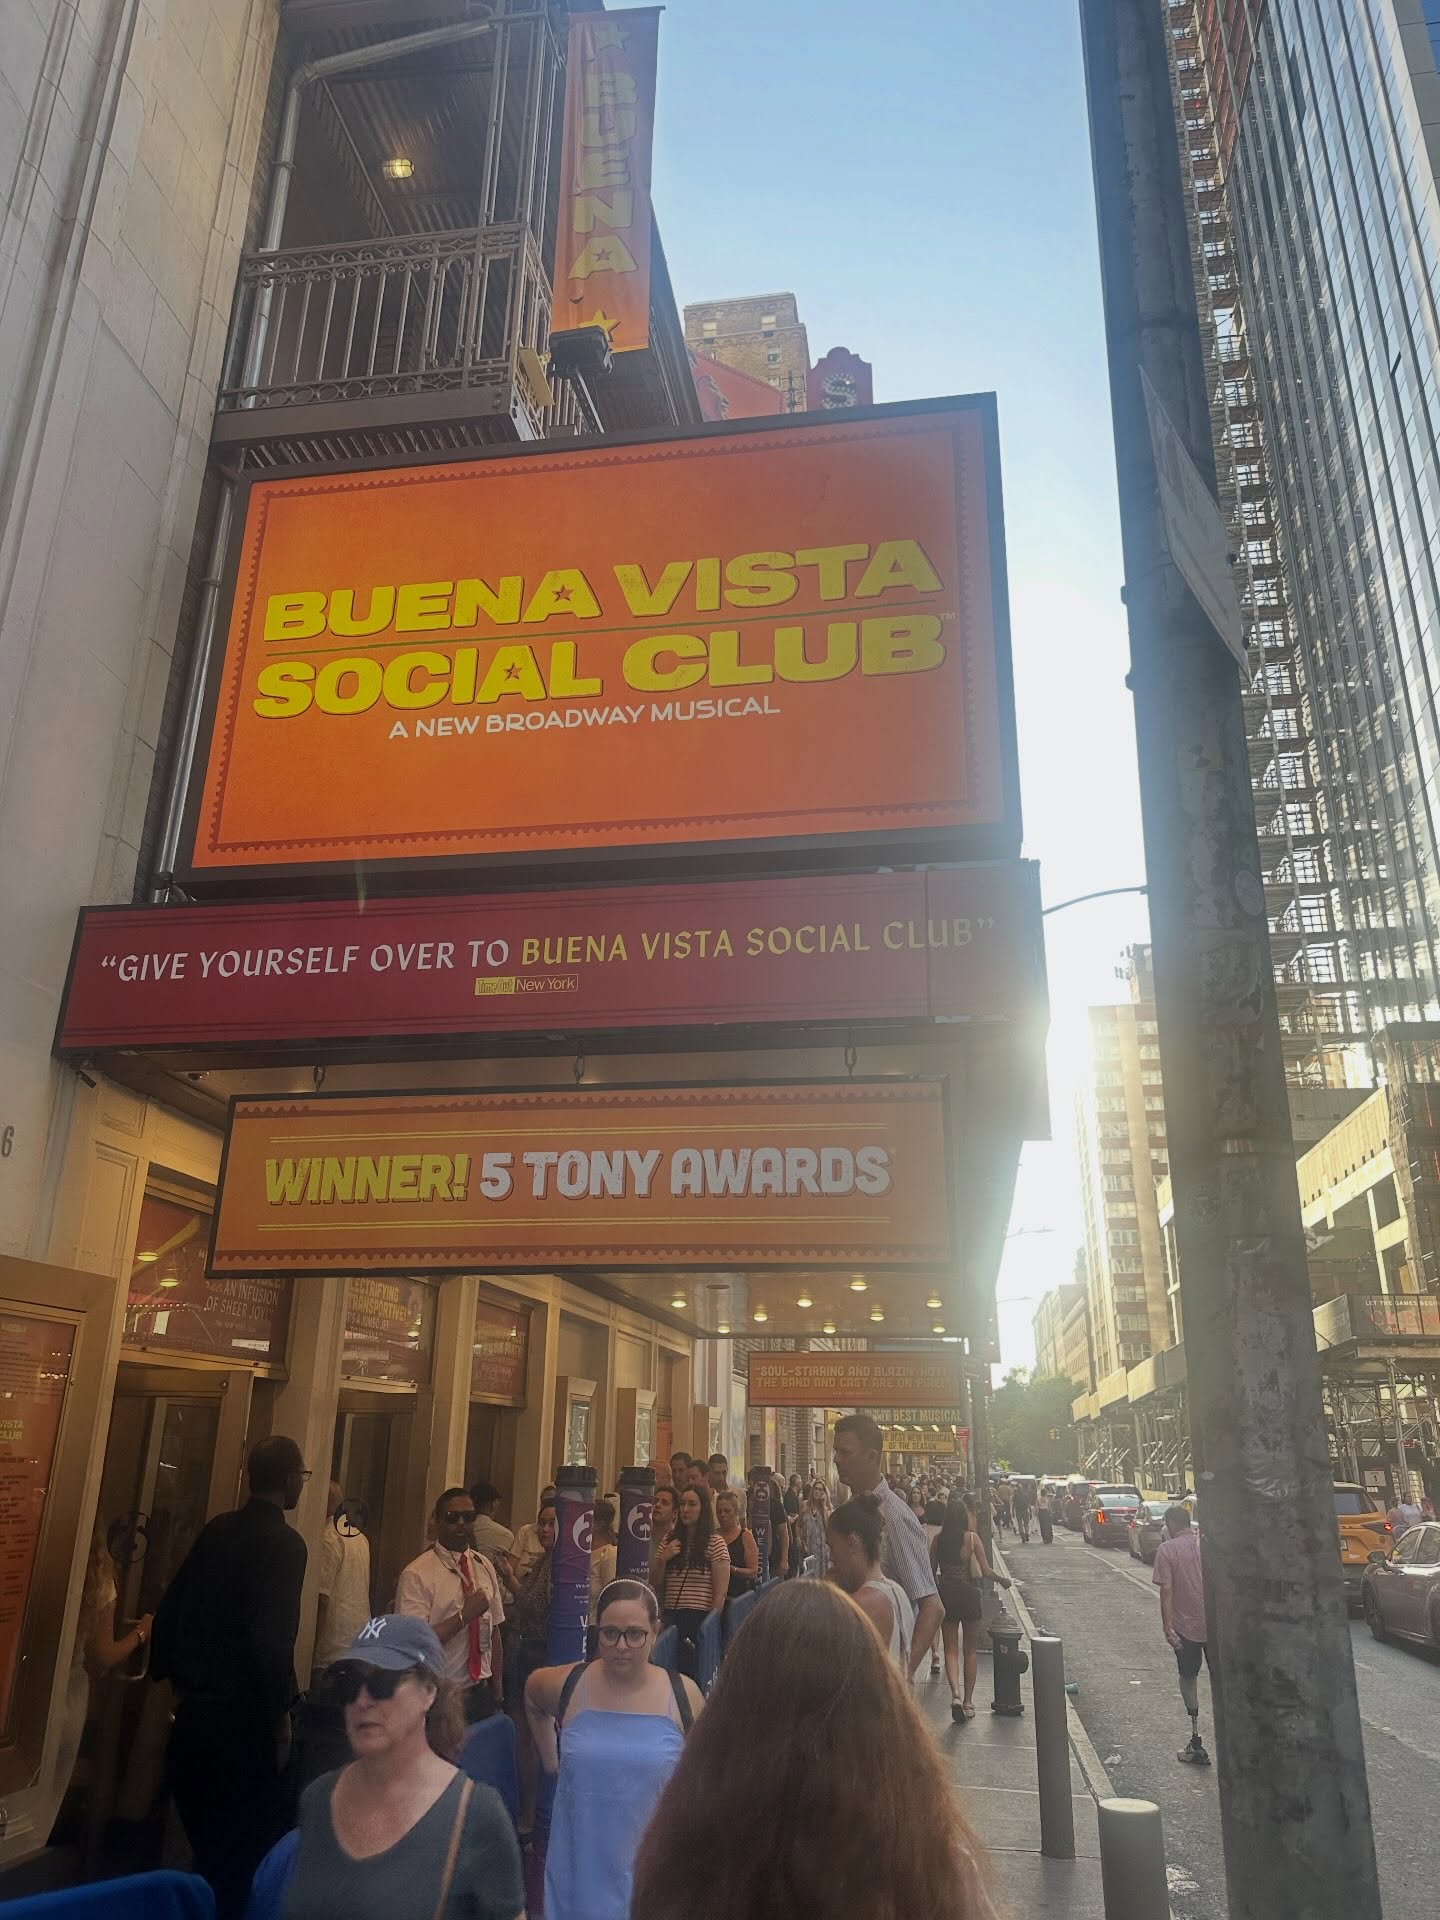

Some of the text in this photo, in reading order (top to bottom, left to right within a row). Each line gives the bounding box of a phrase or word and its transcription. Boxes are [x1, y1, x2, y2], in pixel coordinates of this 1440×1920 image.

[568, 71, 640, 281] BUENA
[822, 372, 857, 409] S
[263, 540, 945, 642] BUENA VISTA
[252, 641, 603, 719] SOCIAL
[622, 613, 946, 693] CLUB
[388, 695, 781, 739] A NEW BROADWAY MUSICAL
[199, 945, 361, 978] YOURSELF
[369, 941, 455, 972] OVER
[467, 939, 510, 968] TO
[521, 933, 629, 966] BUENA
[640, 929, 735, 960] VISTA
[746, 923, 871, 956] SOCIAL
[516, 979, 545, 991] New
[546, 977, 576, 990] York
[265, 1145, 894, 1206] WINNER! 5 TONY AWARDS
[206, 1295, 220, 1312] OF
[223, 1279, 237, 1298] AN
[755, 1377, 779, 1389] THE
[781, 1377, 811, 1389] BAND
[848, 1365, 871, 1378] AND
[893, 1409, 918, 1422] BEST
[919, 1408, 963, 1422] MUSICAL
[358, 1617, 388, 1640] NY
